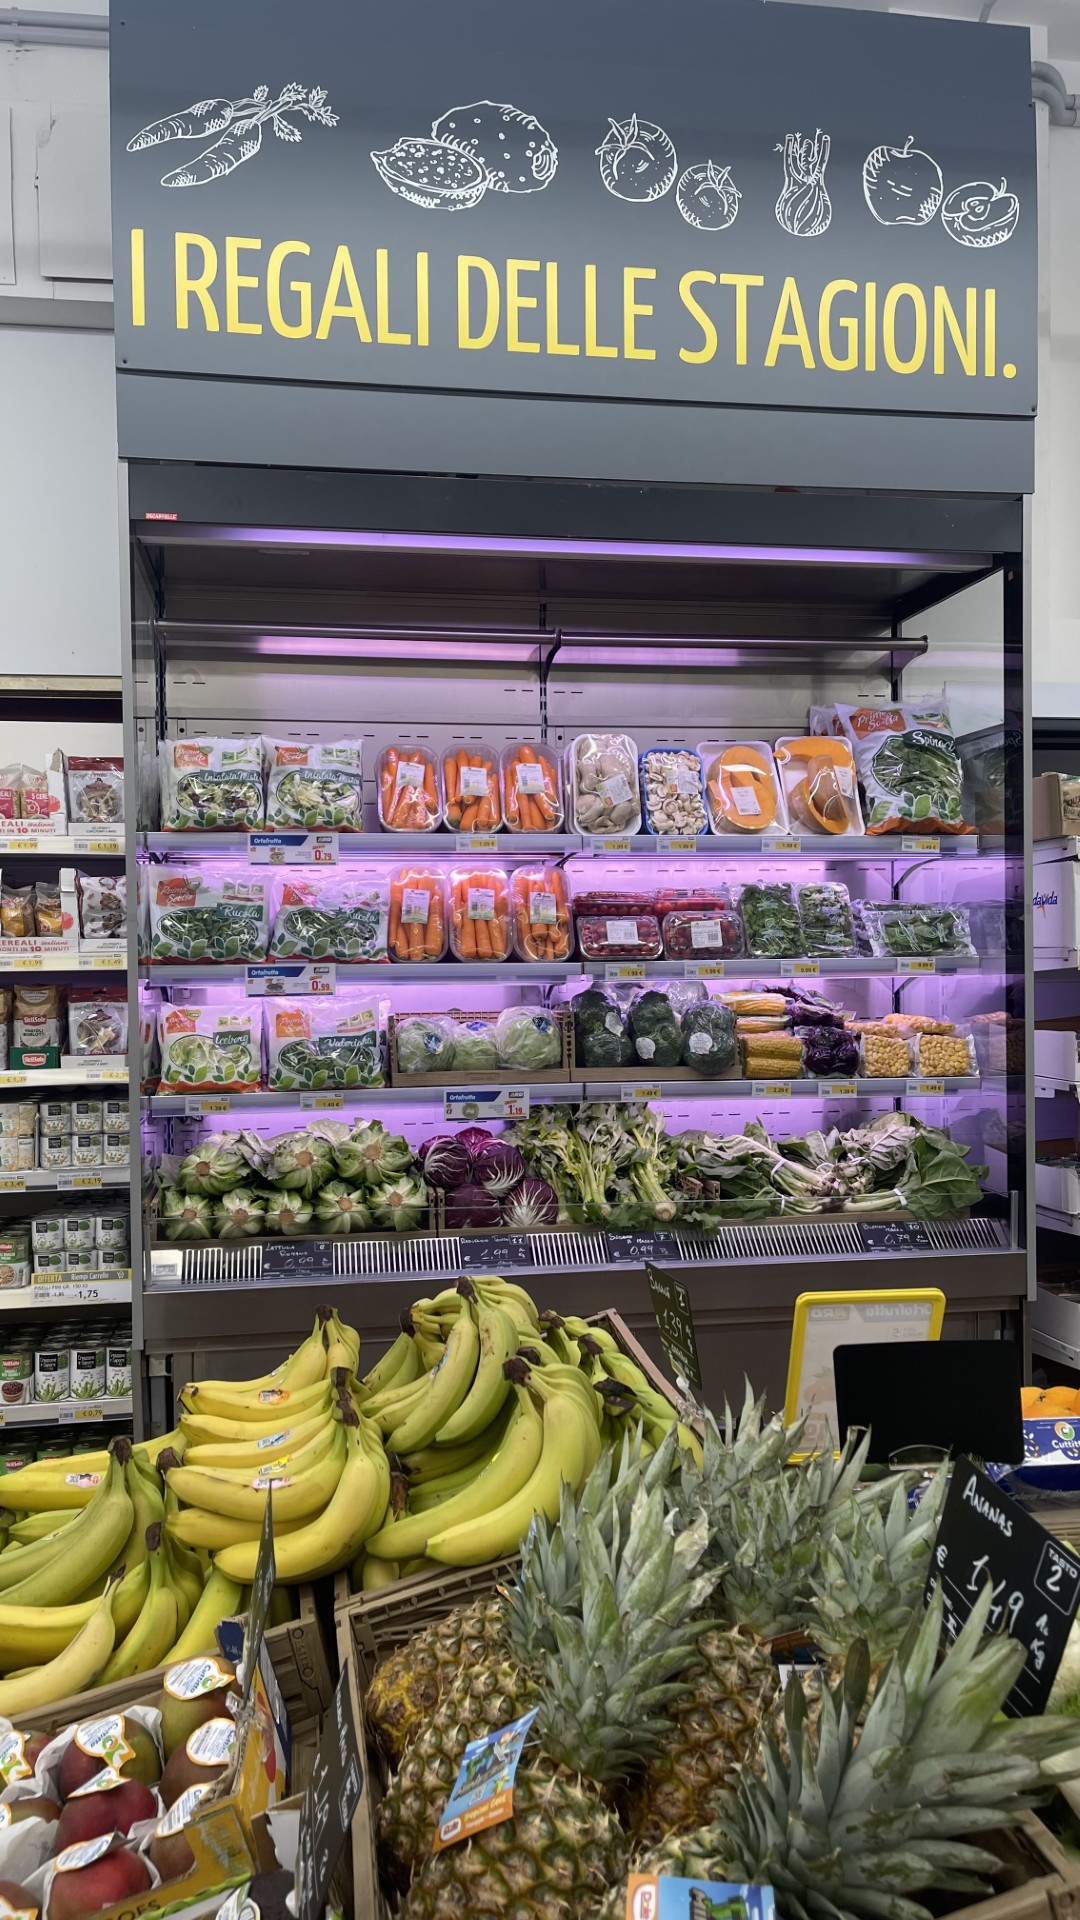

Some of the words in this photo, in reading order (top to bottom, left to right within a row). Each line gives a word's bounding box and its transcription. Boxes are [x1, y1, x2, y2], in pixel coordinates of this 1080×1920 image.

[132, 229, 145, 326] I
[176, 234, 430, 347] REGALI
[458, 256, 657, 362] DELLE
[679, 271, 1017, 379] STAGIONI.
[912, 731, 956, 751] Spinaci
[204, 771, 237, 782] Insalata
[304, 771, 337, 781] Insalata
[223, 904, 260, 919] Rucola
[215, 1034, 249, 1047] Iceberg
[89, 1272, 109, 1280] Carrello
[78, 1289, 98, 1299] 1,75
[962, 1474, 1014, 1538] ANANAS
[1048, 1547, 1078, 1580] TASTO
[1045, 1564, 1063, 1592] 2
[190, 1664, 211, 1693] Cuttitta
